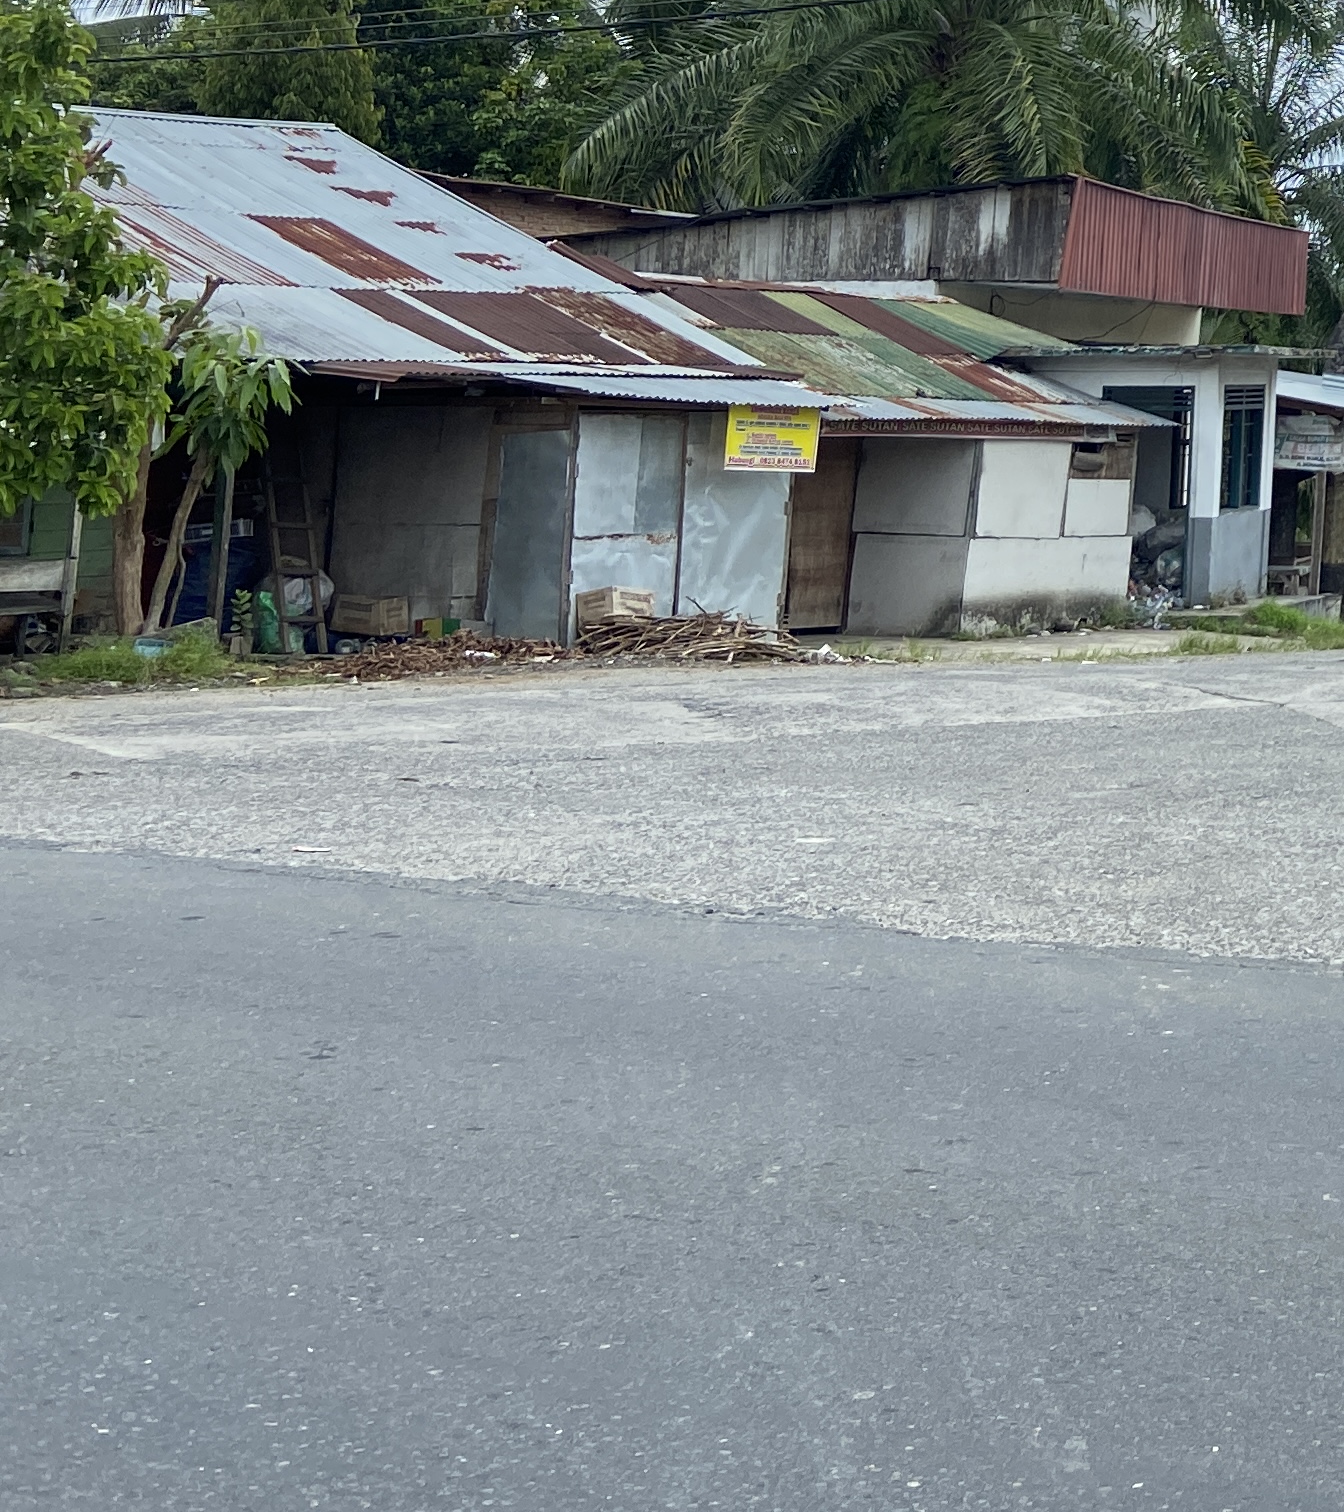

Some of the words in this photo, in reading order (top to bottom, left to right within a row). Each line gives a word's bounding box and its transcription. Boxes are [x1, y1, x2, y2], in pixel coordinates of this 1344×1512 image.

[861, 421, 898, 431] SUTAN
[902, 421, 928, 431] SATE
[930, 422, 965, 432] SUTAN
[968, 423, 993, 433] SATE
[994, 423, 1026, 434] SUTAN
